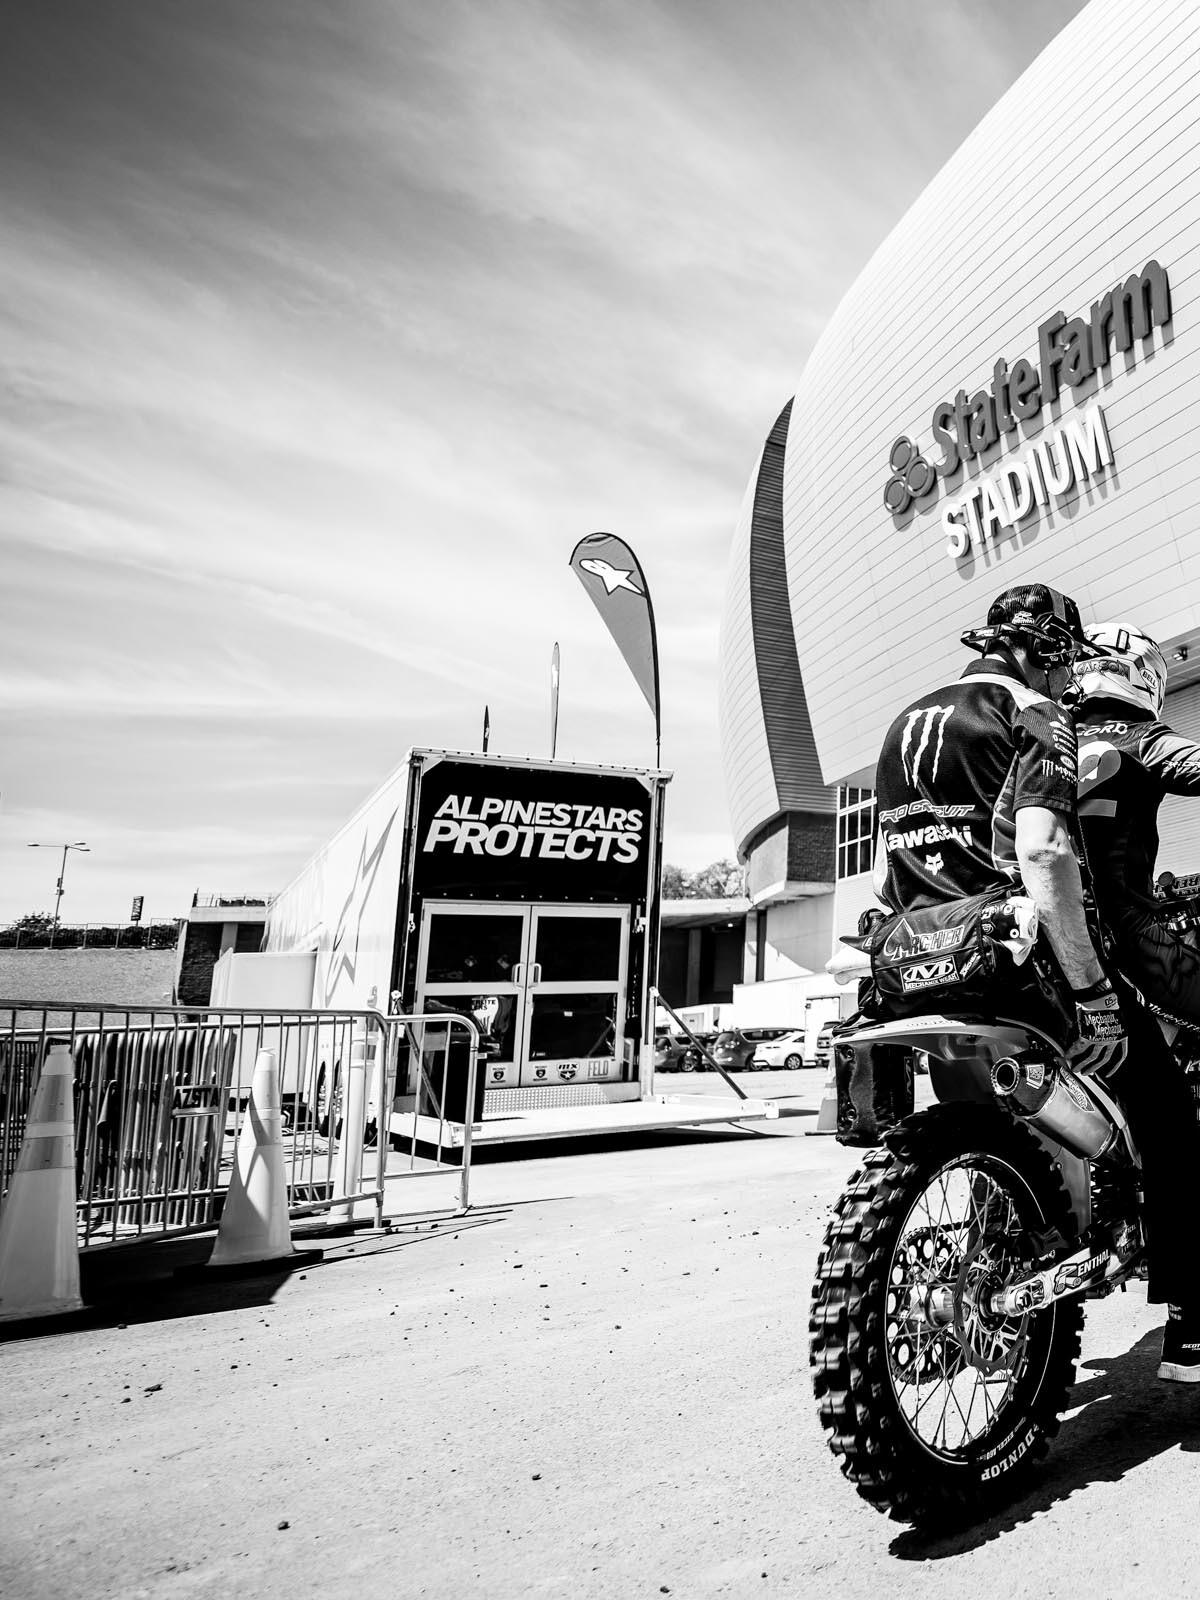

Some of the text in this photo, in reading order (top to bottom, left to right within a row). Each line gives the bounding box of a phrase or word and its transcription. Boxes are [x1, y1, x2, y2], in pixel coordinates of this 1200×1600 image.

[942, 405, 1114, 558] STADIUM
[1142, 670, 1157, 687] BELL
[434, 795, 643, 831] ALPINESTARS
[423, 819, 642, 863] PROTECTS
[904, 972, 958, 991] MECHANIX WEAR
[981, 1428, 1035, 1481] DUNLOP
